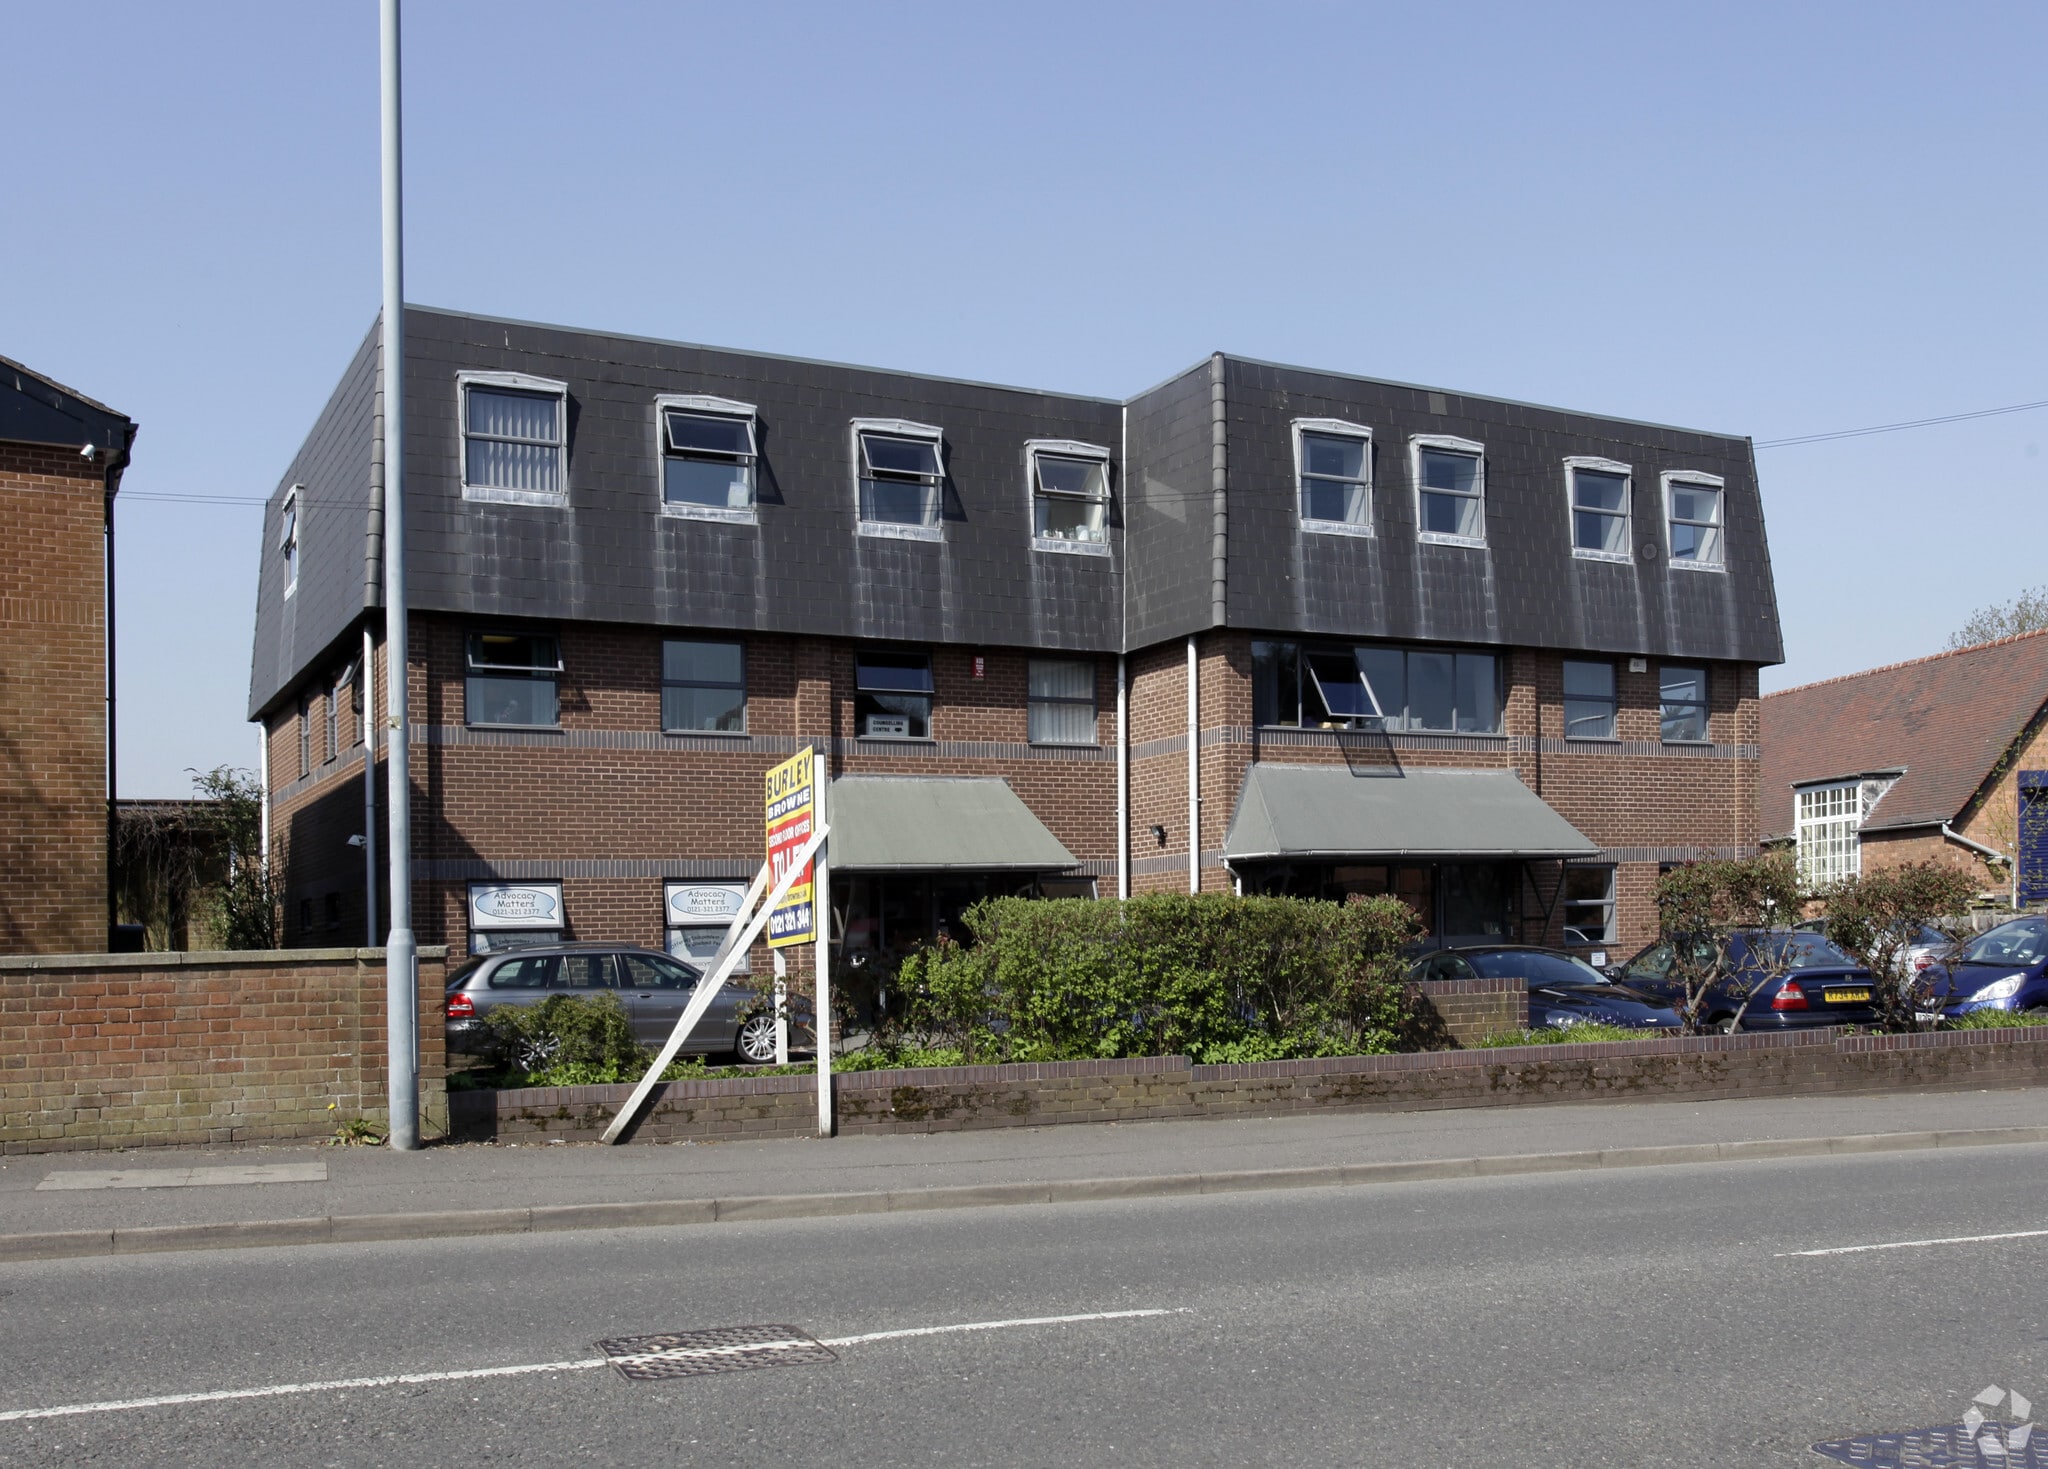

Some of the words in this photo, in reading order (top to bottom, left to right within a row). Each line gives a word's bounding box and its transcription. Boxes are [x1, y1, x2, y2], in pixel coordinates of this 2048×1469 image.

[767, 754, 810, 800] BURLEY
[768, 788, 810, 820] BROWNE
[493, 892, 536, 900] Advocacy
[770, 913, 784, 935] 0121
[785, 910, 796, 931] 321
